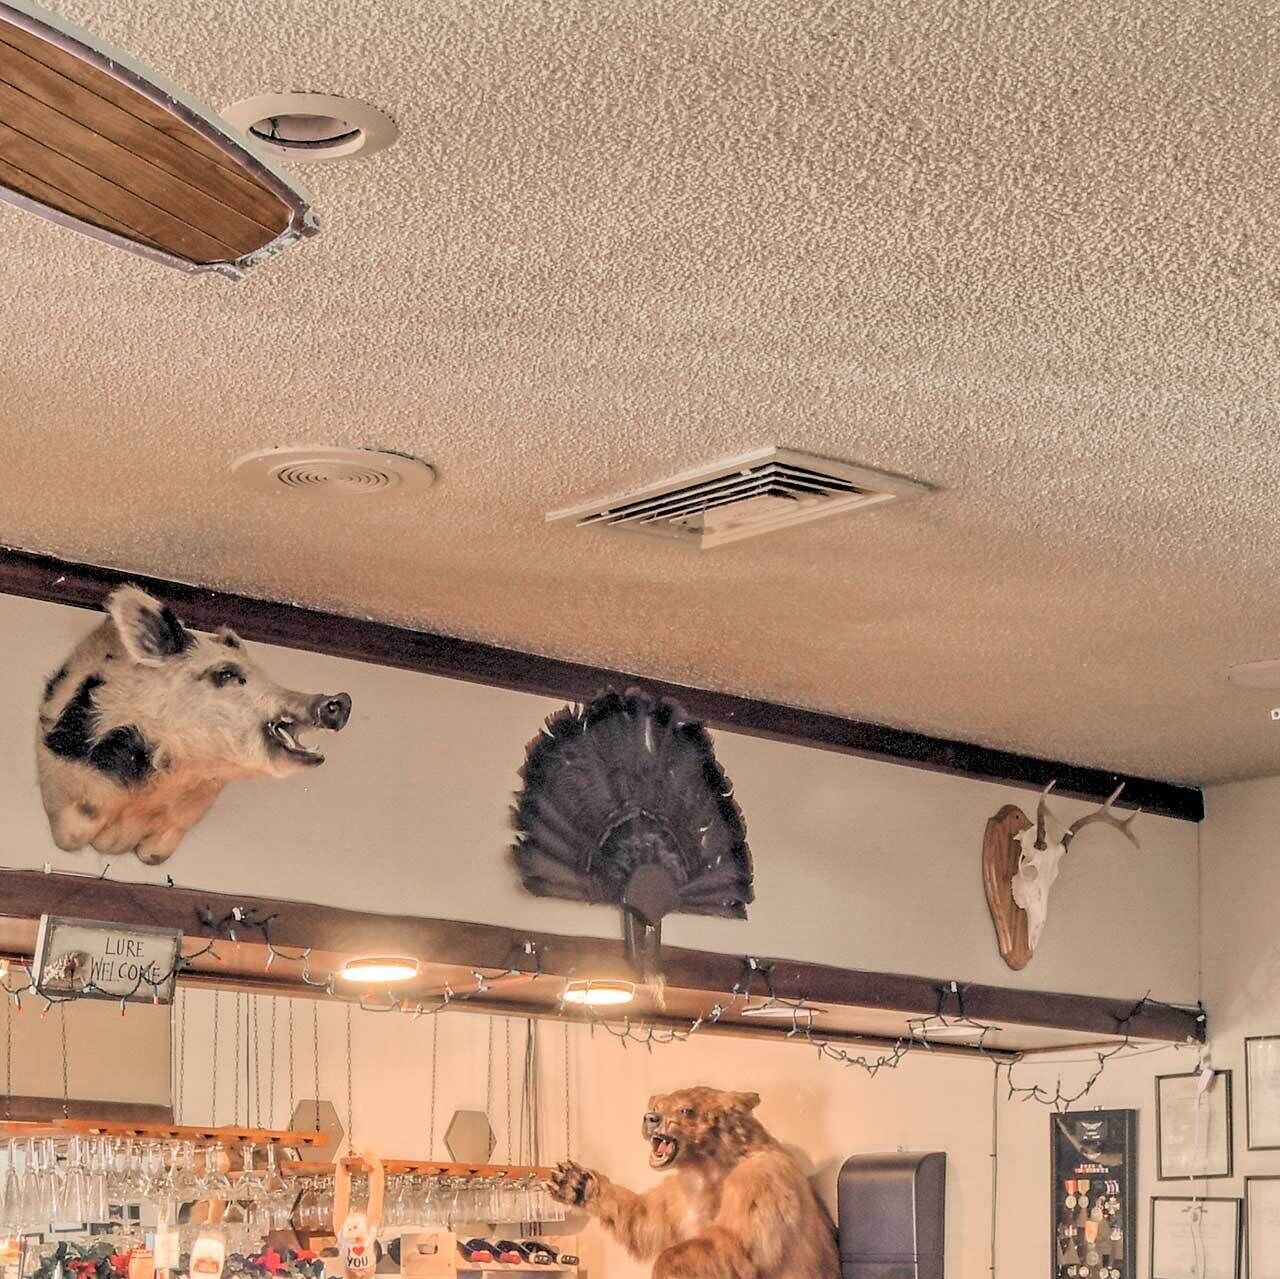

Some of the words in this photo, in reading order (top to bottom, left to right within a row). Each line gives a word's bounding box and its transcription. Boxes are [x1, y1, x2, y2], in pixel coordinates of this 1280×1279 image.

[105, 937, 145, 957] LURE
[90, 957, 161, 982] WELCOME
[347, 1256, 368, 1268] YOU
